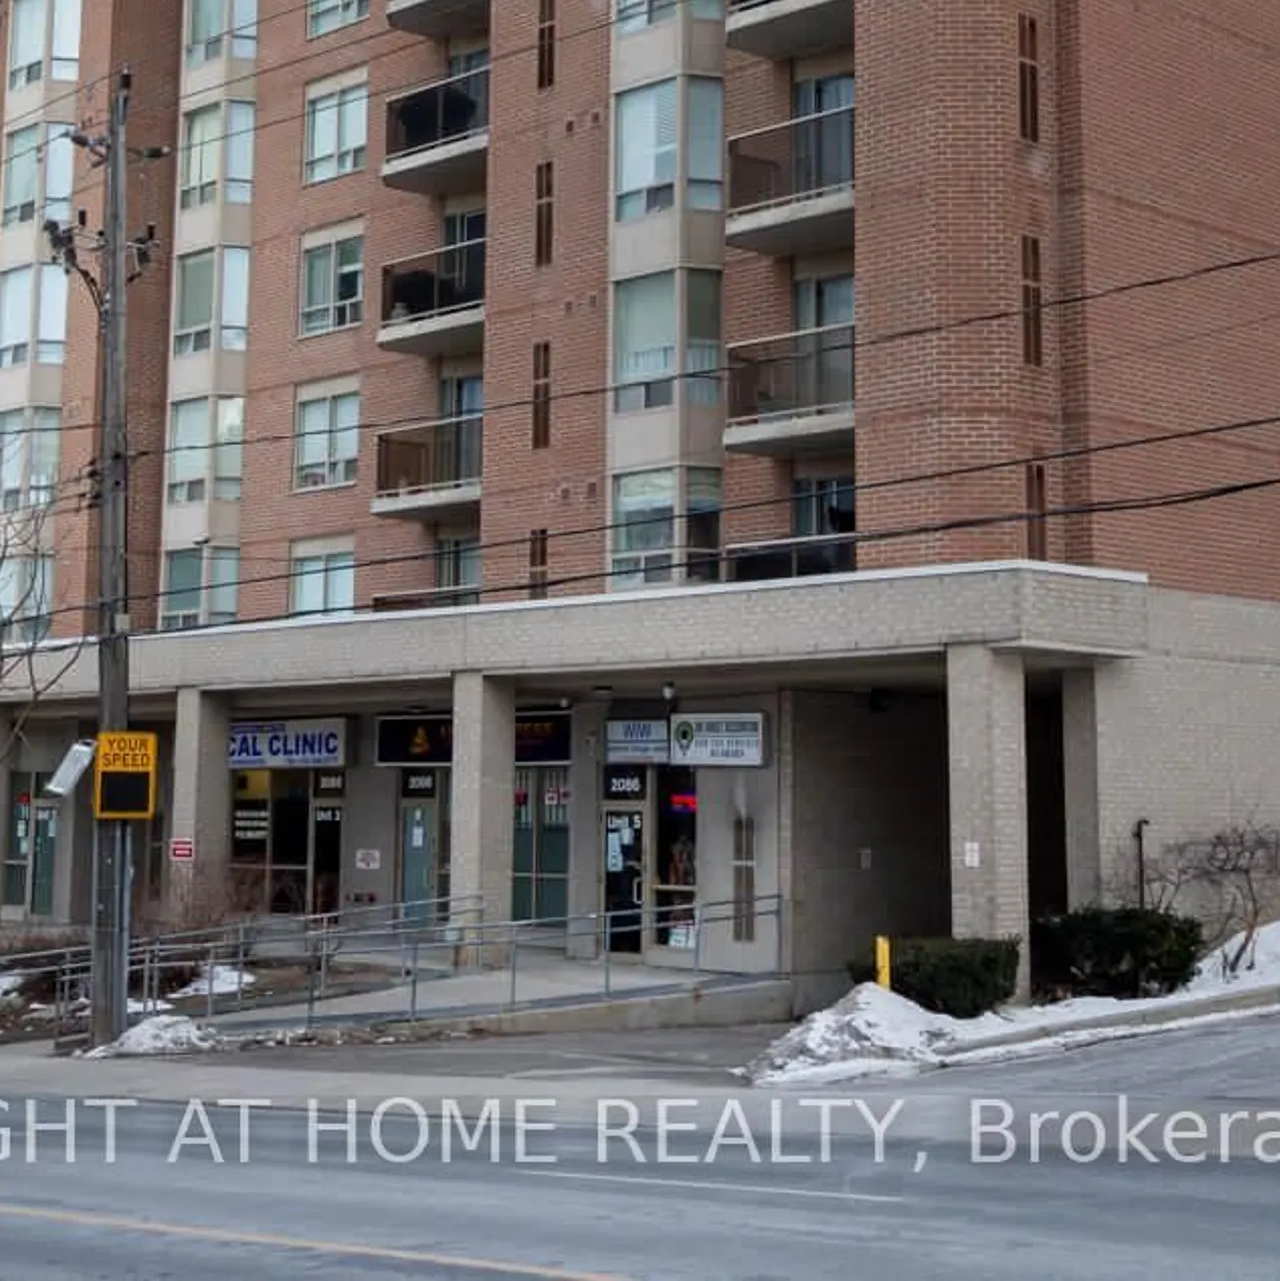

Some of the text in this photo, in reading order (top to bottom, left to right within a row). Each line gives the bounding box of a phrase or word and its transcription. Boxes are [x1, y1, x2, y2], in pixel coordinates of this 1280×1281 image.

[107, 738, 149, 752] YOUR
[268, 731, 339, 757] CLINIC
[102, 753, 151, 768] SPEED
